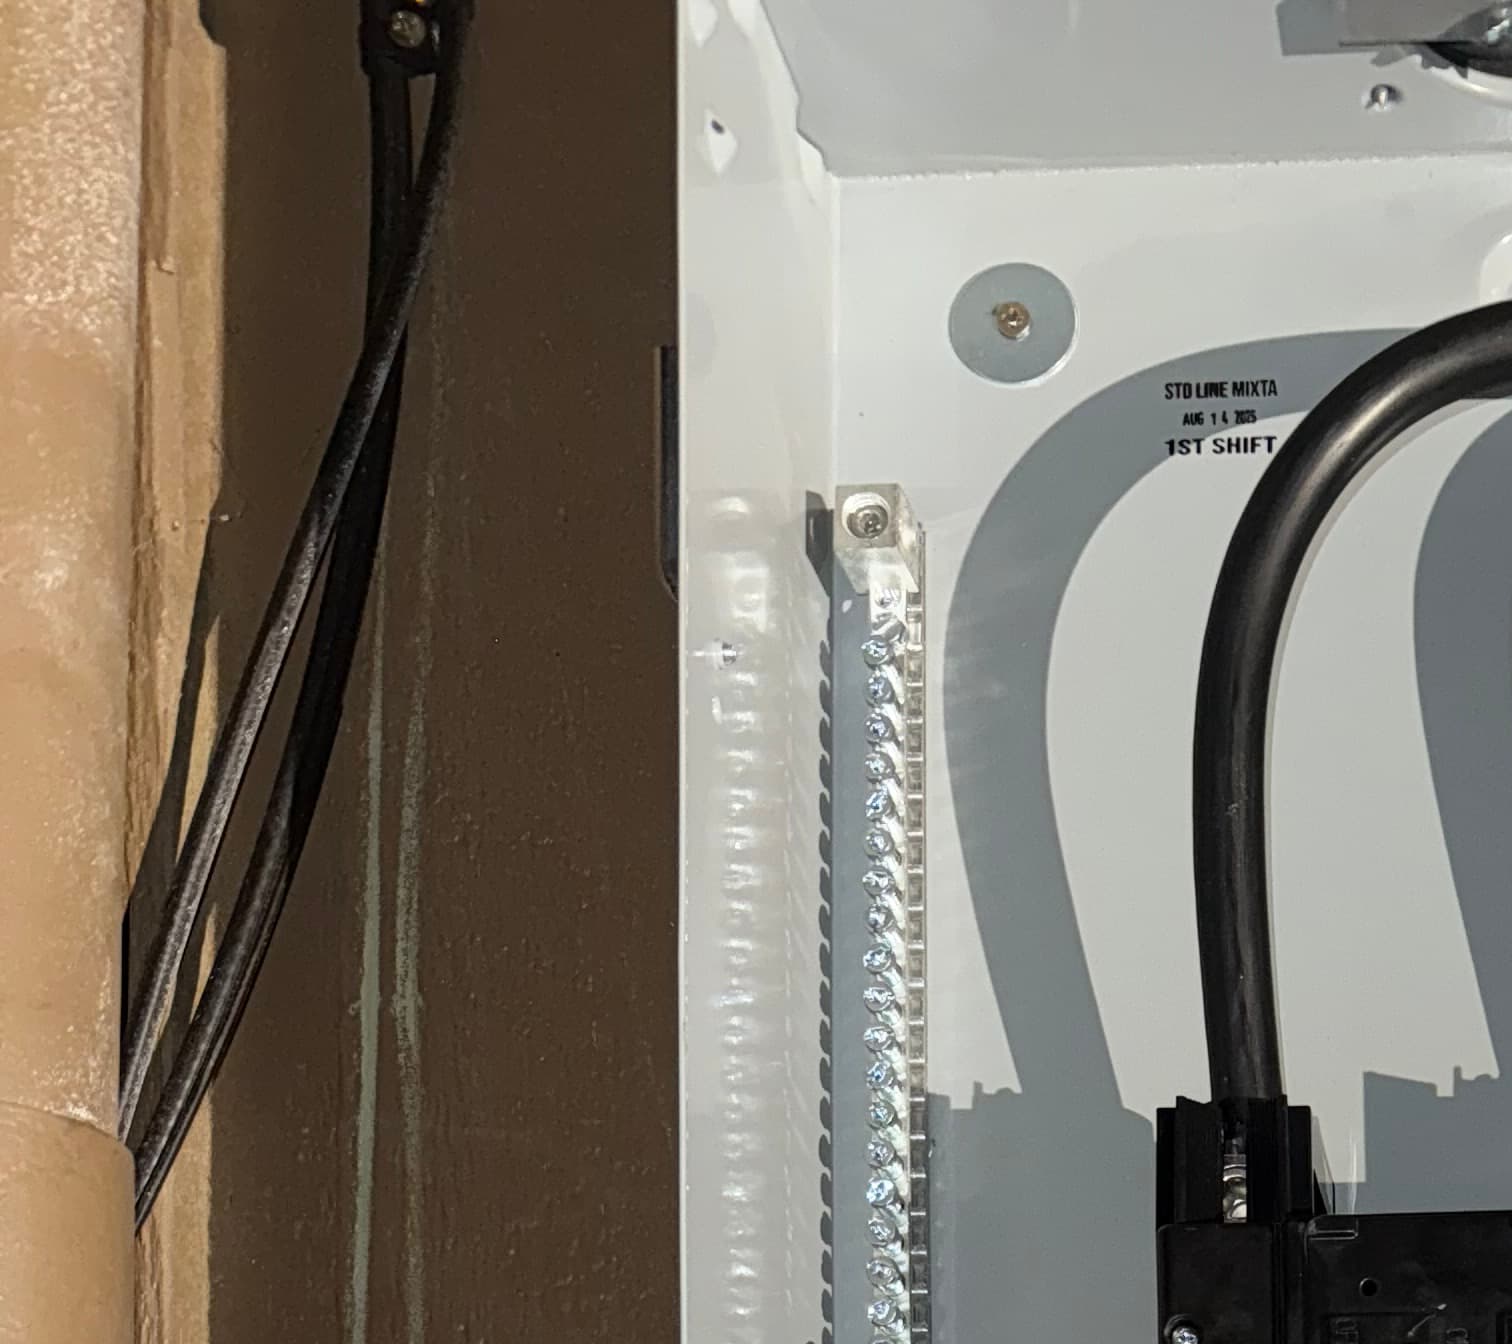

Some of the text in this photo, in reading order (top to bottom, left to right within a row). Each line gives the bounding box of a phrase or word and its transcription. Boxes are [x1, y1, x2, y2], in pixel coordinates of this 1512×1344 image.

[1164, 379, 1278, 400] STD LINE MIXTA
[1182, 411, 1205, 426] AUG
[1164, 436, 1278, 456] 1ST SHIFT
